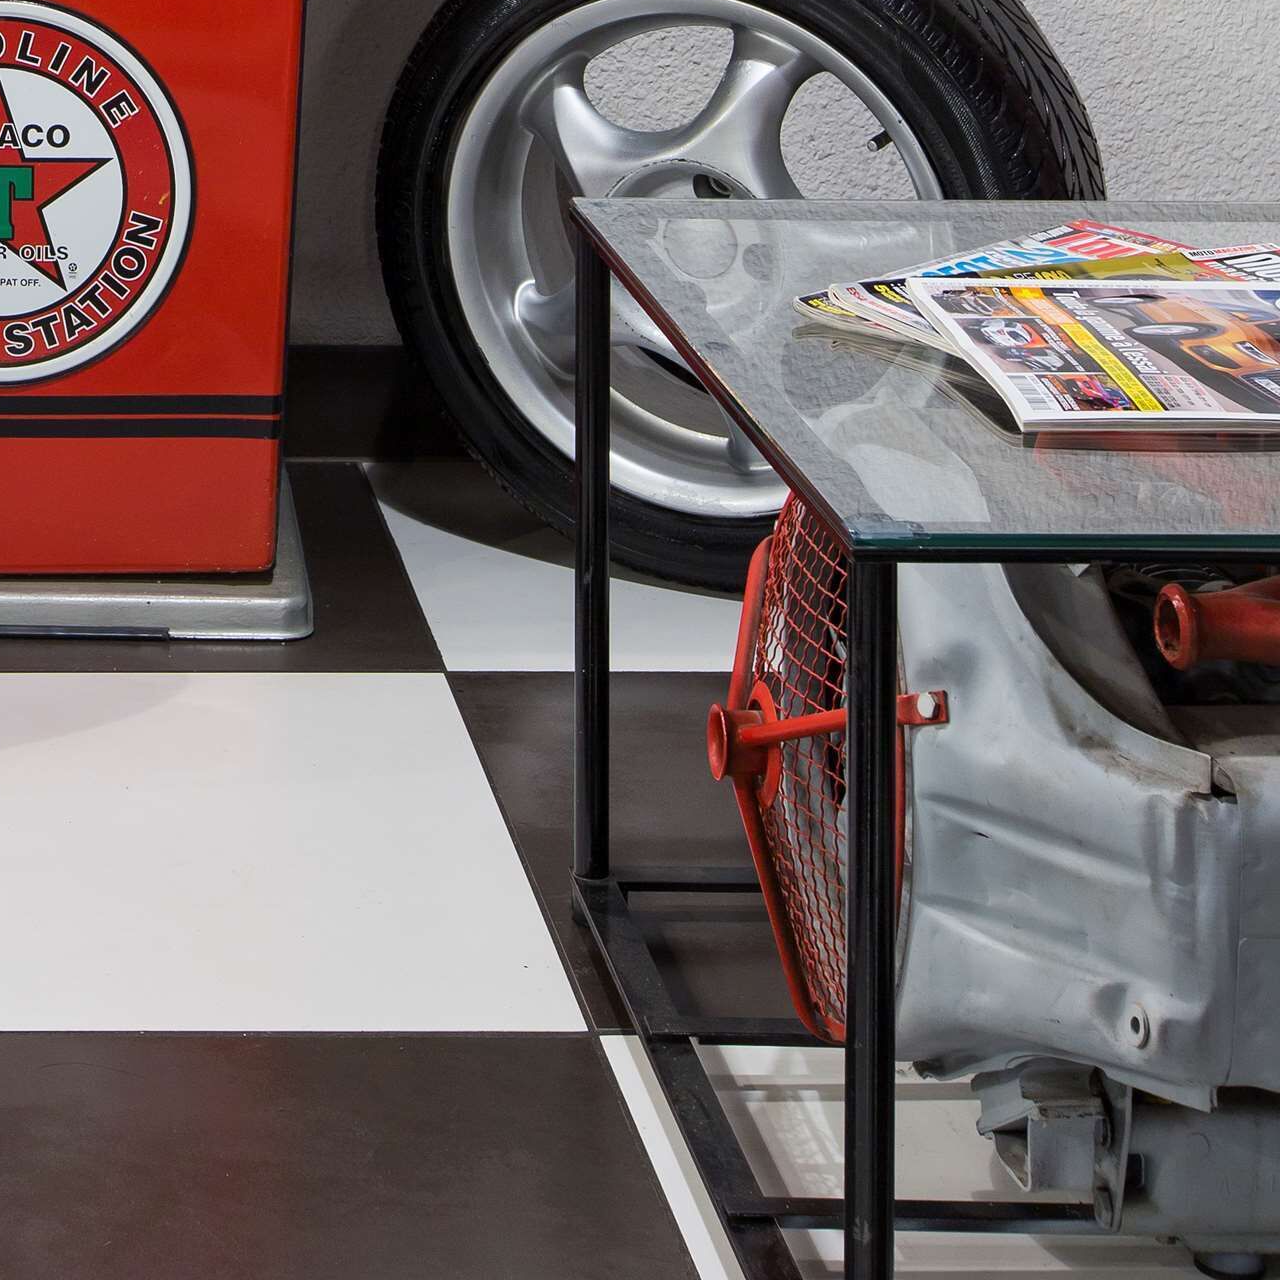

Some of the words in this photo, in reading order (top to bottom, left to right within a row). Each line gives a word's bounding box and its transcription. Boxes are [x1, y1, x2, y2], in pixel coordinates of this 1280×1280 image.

[19, 244, 69, 261] OILS
[0, 278, 18, 287] PAT
[20, 278, 41, 287] OFF.
[3, 210, 164, 357] STATION
